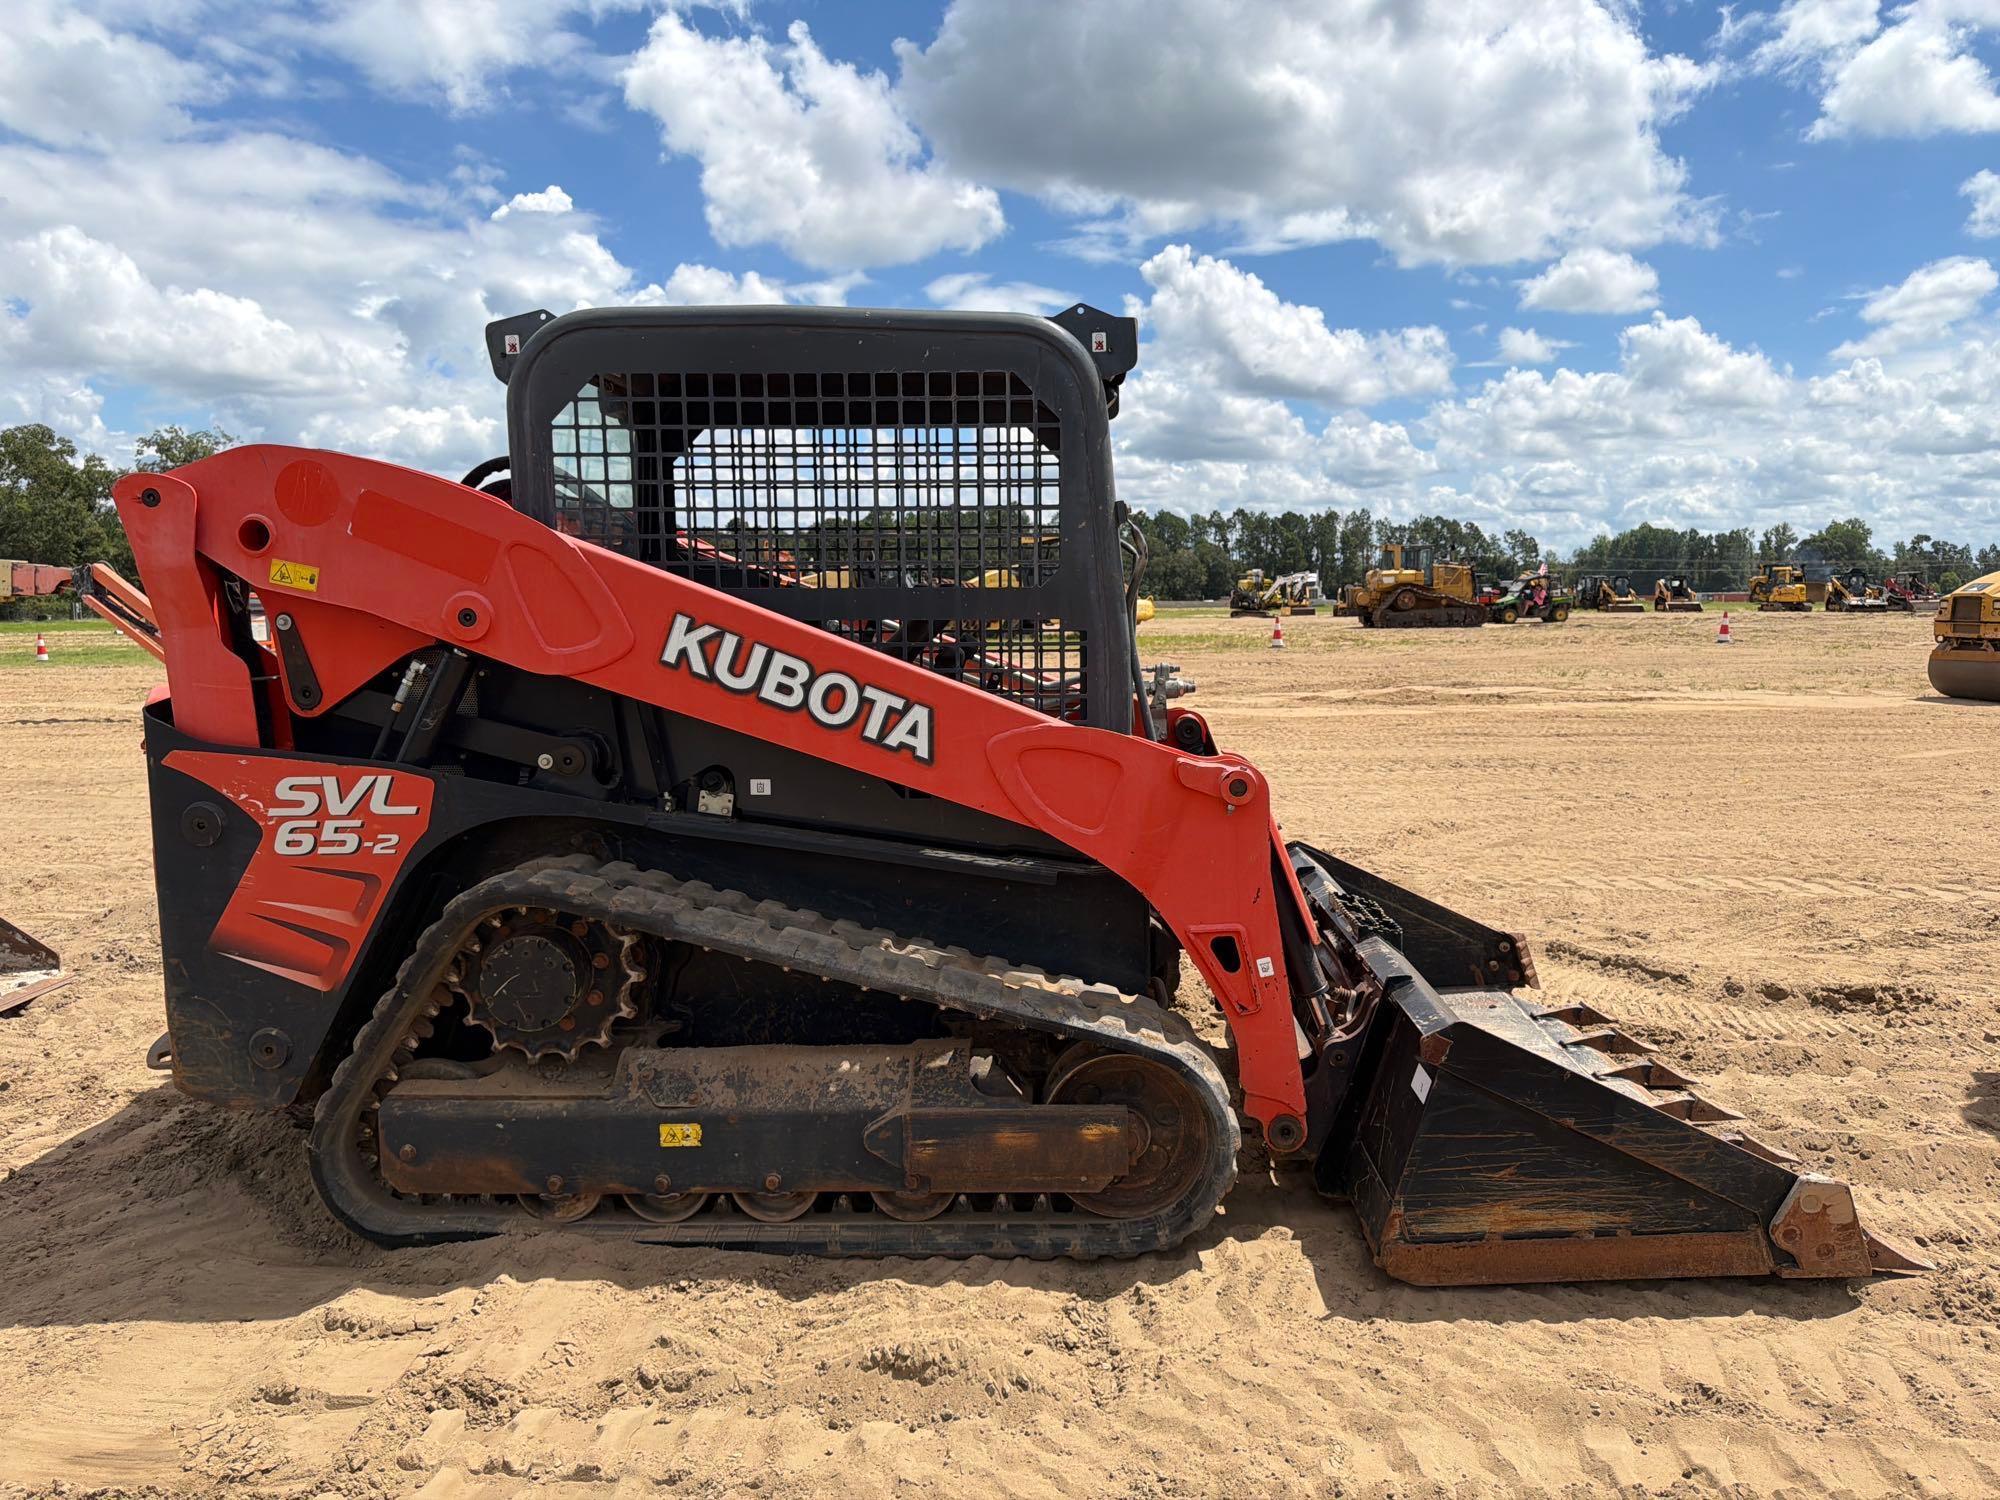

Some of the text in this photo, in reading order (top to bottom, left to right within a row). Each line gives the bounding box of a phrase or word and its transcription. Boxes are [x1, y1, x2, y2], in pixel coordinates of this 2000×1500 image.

[660, 612, 932, 761] KUBOTA
[267, 775, 419, 816] SVL
[274, 820, 400, 855] 65-2
